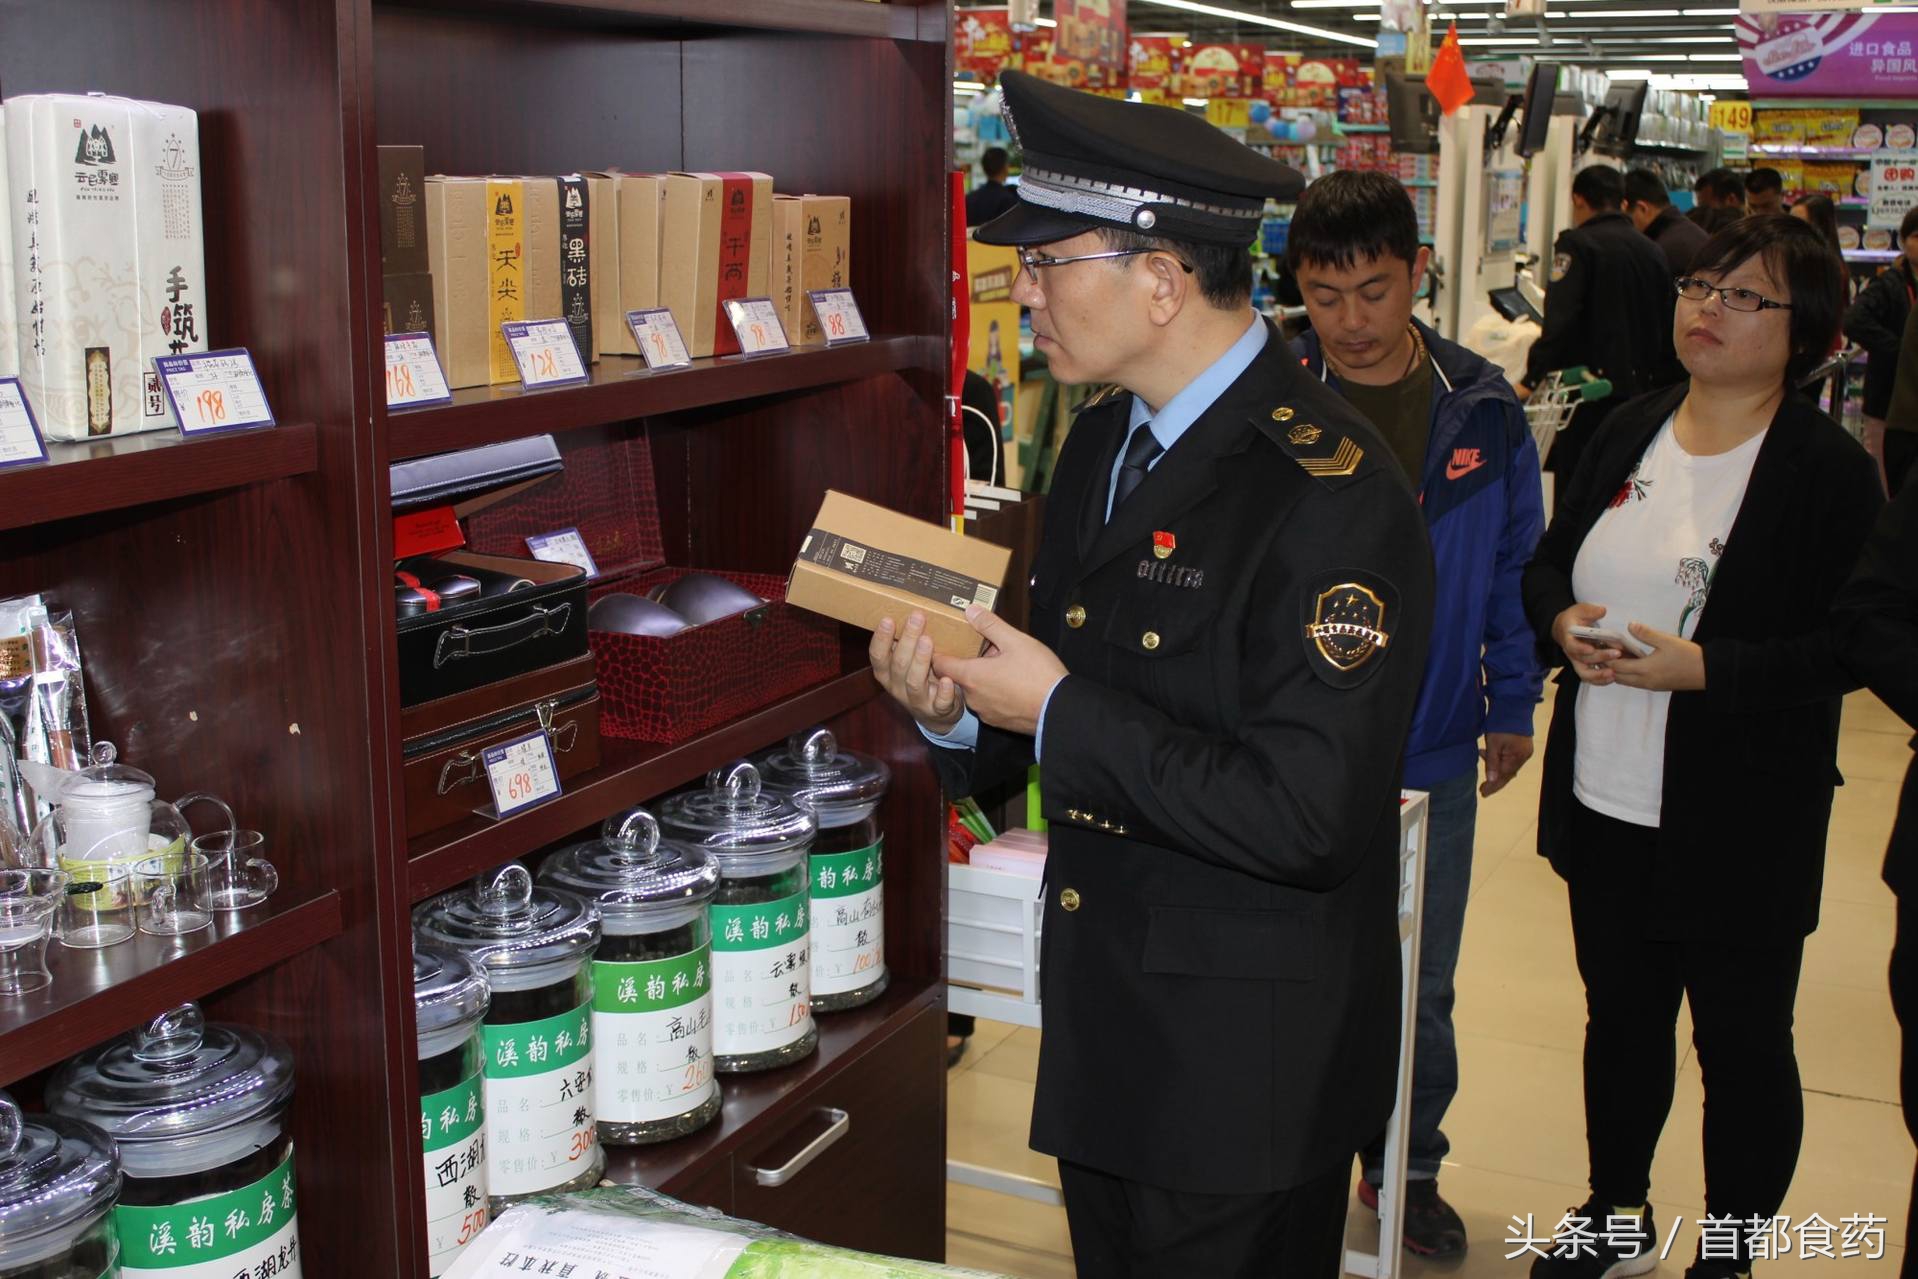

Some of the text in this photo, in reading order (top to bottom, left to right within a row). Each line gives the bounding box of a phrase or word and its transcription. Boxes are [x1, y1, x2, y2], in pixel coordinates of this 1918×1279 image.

[1849, 41, 1912, 57] 进口食品
[496, 250, 517, 301] 天尖
[568, 238, 587, 287] 黑砖
[751, 323, 766, 348] 98
[828, 313, 845, 336] 88
[651, 332, 668, 362] 98
[531, 349, 560, 382] 128
[387, 364, 416, 399] 168
[197, 390, 225, 425] 198
[1451, 447, 1480, 466] NIKE
[508, 772, 532, 799] 698
[150, 1171, 294, 1255] 溪韵私房茶
